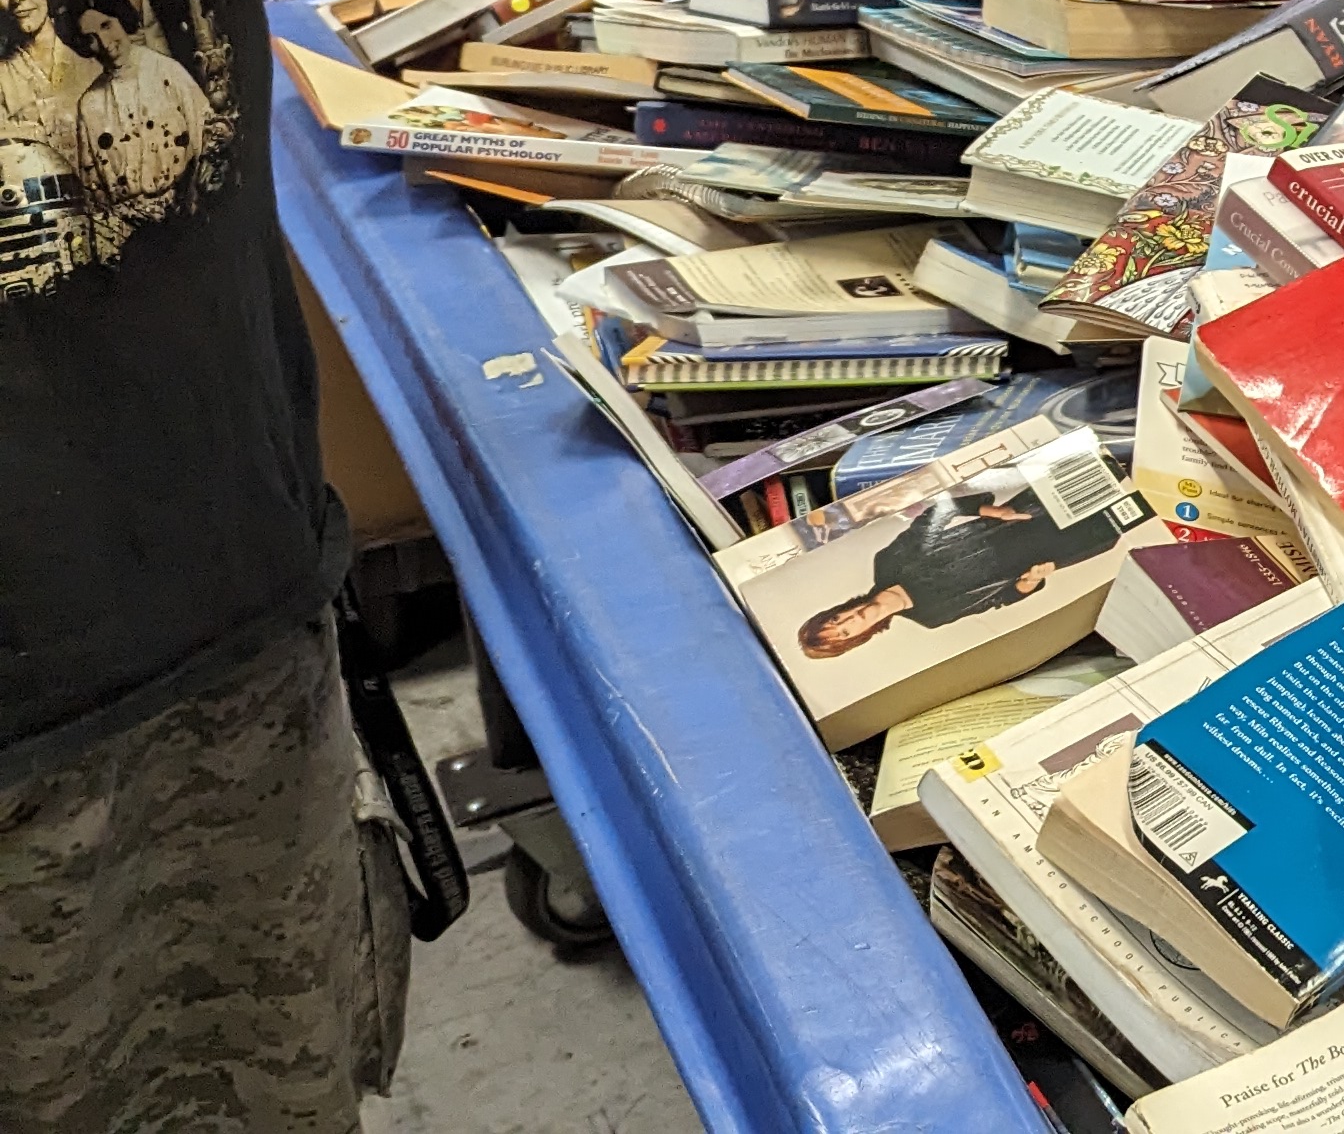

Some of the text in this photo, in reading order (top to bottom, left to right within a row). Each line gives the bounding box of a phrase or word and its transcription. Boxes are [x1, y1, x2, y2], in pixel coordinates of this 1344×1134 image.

[1305, 18, 1344, 67] RYAN
[386, 129, 409, 149] 50
[412, 141, 563, 162] POPULAR PSYCHOLOGY
[413, 131, 526, 148] GREAT MYTHS OF
[1299, 145, 1331, 164] OVER
[1229, 211, 1272, 255] Crucial
[1305, 654, 1337, 685] through
[1281, 669, 1303, 688] visits
[1302, 687, 1318, 701] the
[1317, 699, 1343, 724] Island
[1202, 721, 1233, 748] wildest
[1248, 719, 1269, 739] Milo
[1268, 737, 1301, 766] realizes
[1144, 752, 1157, 764] US
[1195, 794, 1214, 811] CAN
[1012, 833, 1067, 889] AMSCO
[1080, 904, 1144, 972] SCHOOL
[1237, 892, 1295, 950] YEARLING CLASSIC
[1219, 1080, 1271, 1109] Praise
[1271, 1072, 1296, 1090] for
[1295, 1056, 1327, 1078] The
